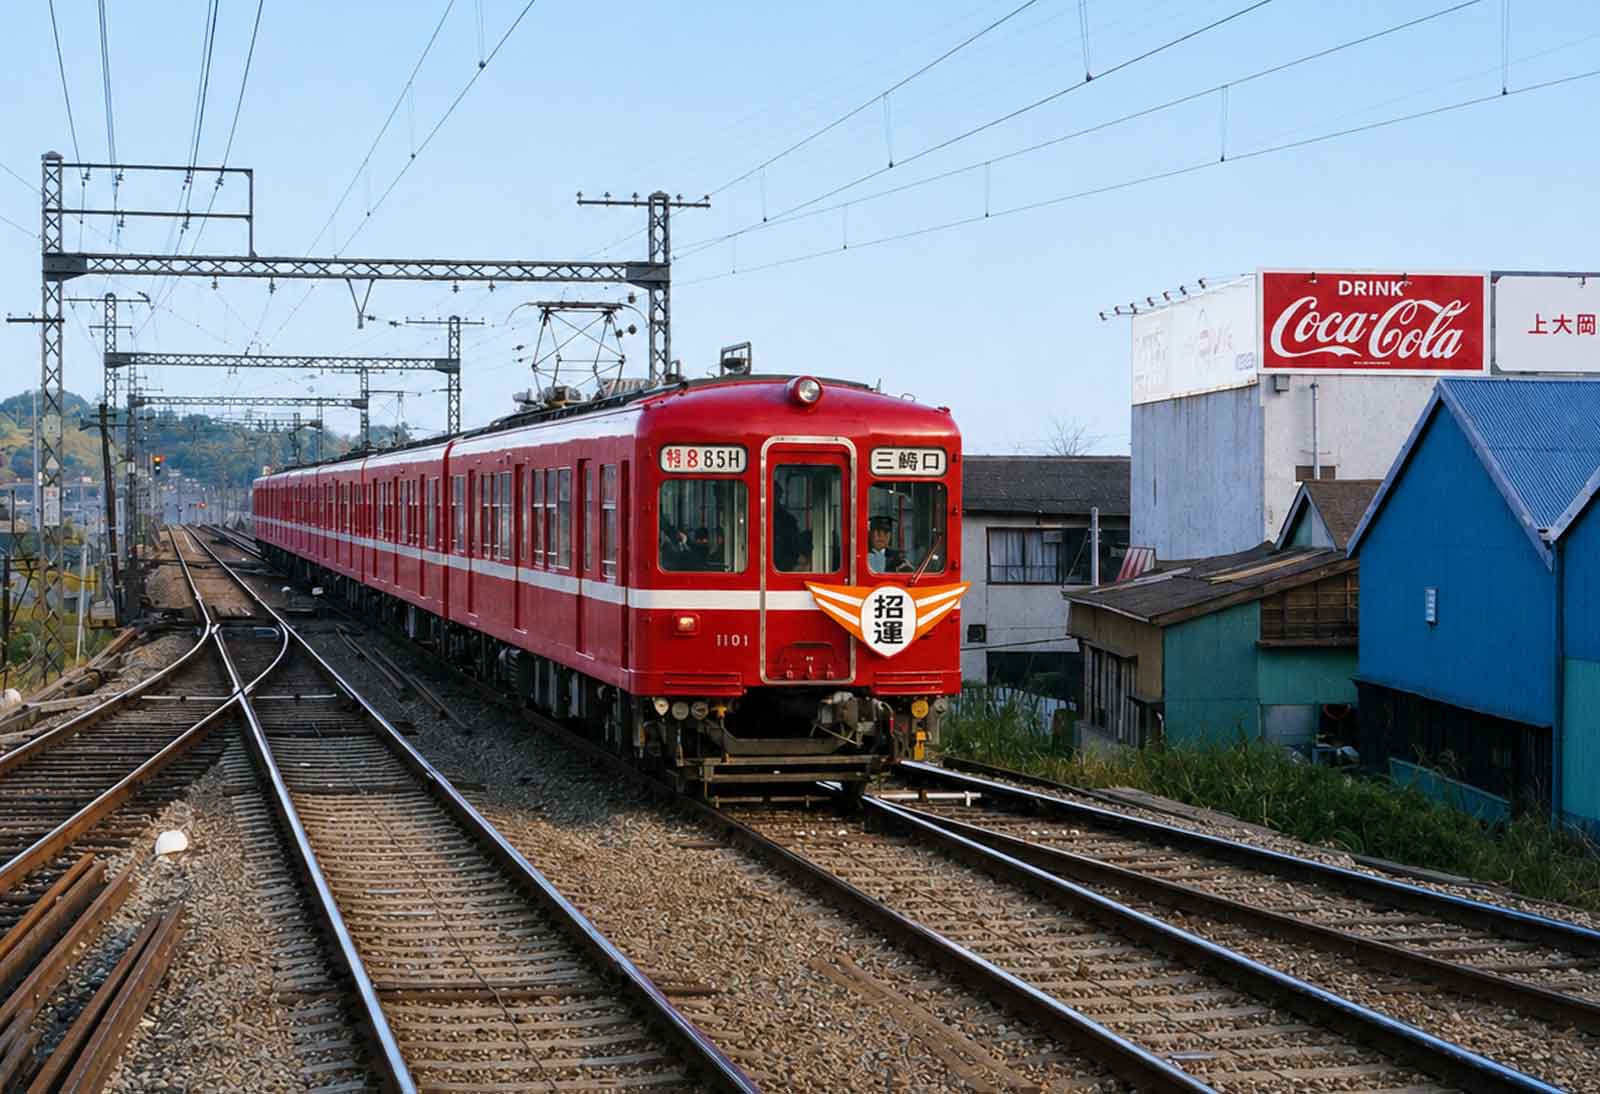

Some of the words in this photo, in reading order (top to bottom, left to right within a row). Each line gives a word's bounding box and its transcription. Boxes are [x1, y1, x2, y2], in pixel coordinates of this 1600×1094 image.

[1338, 280, 1404, 296] DRINK
[1270, 296, 1470, 359] Coca-Cola
[1528, 312, 1596, 335] 上大岡
[873, 595, 904, 644] 招運
[717, 633, 748, 647] 1101
